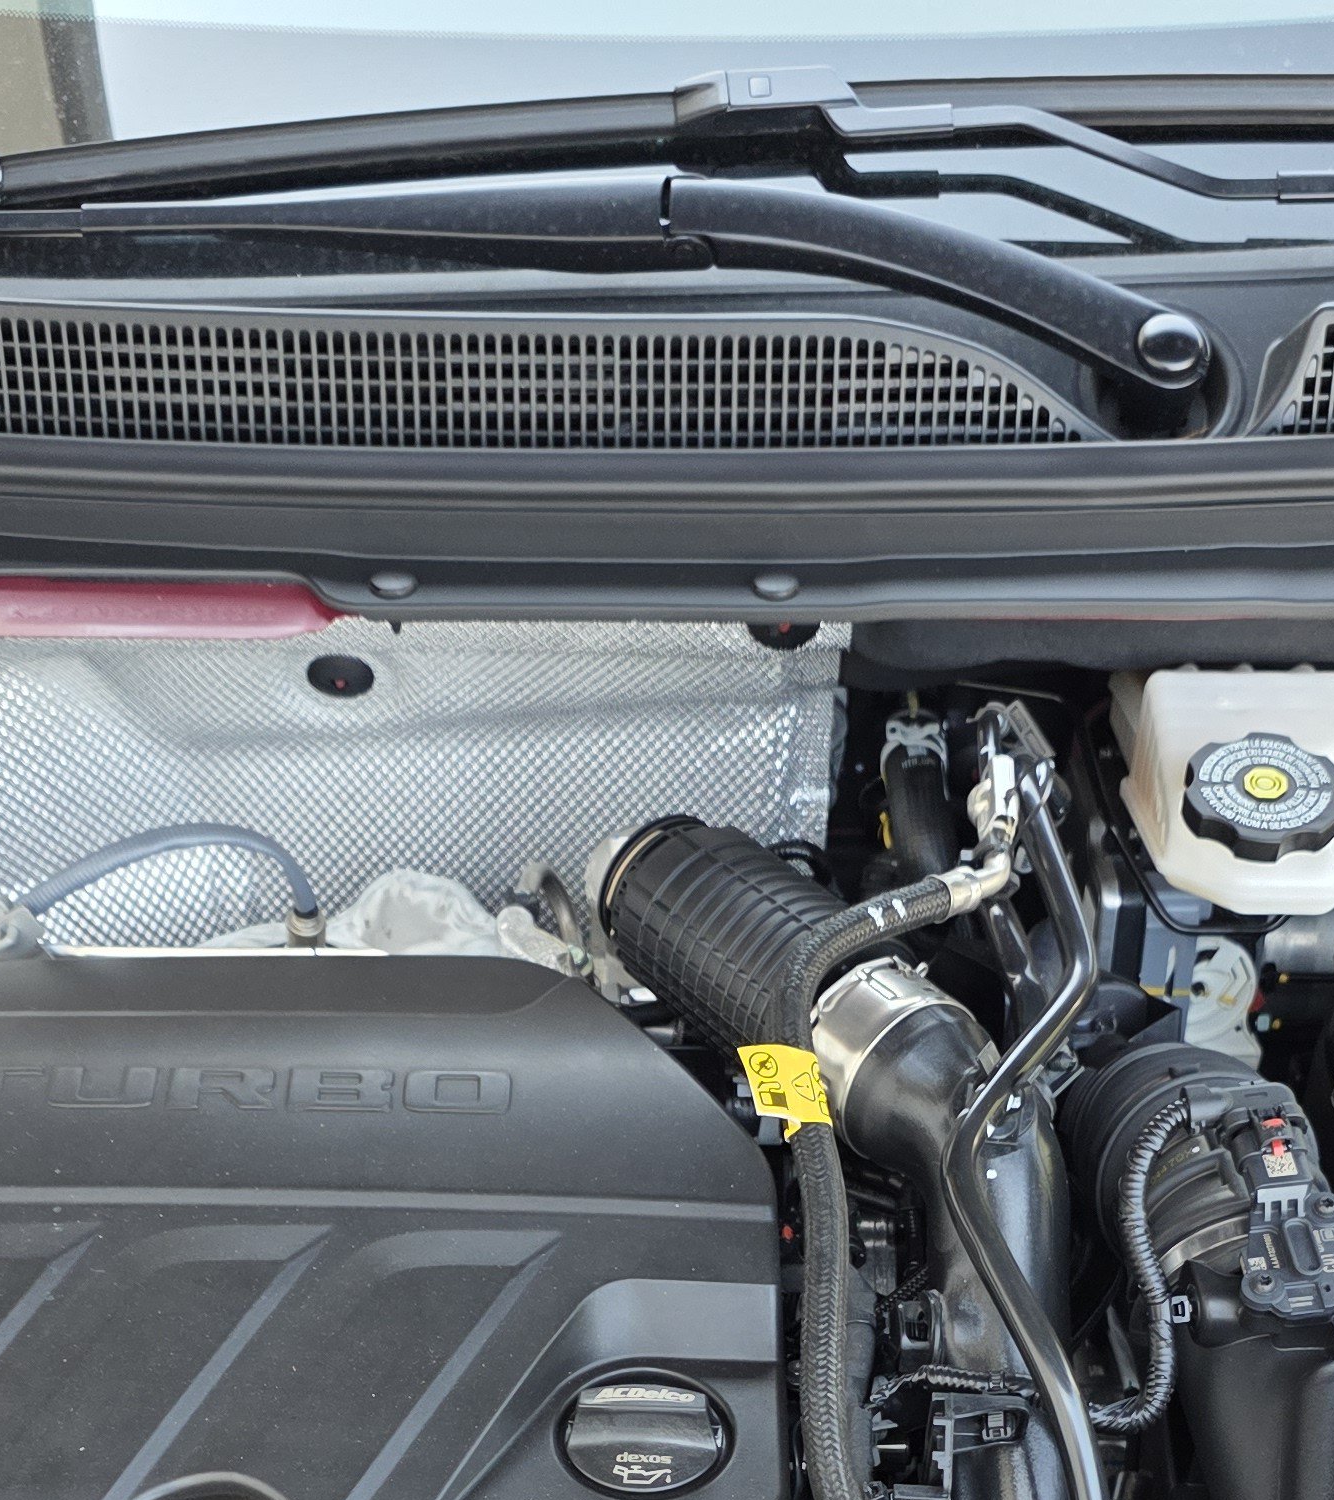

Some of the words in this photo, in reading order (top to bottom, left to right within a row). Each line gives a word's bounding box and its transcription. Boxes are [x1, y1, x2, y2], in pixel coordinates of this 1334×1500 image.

[1235, 814, 1260, 829] FROM
[594, 1387, 695, 1402] ACDelco
[615, 1452, 673, 1464] dexos
